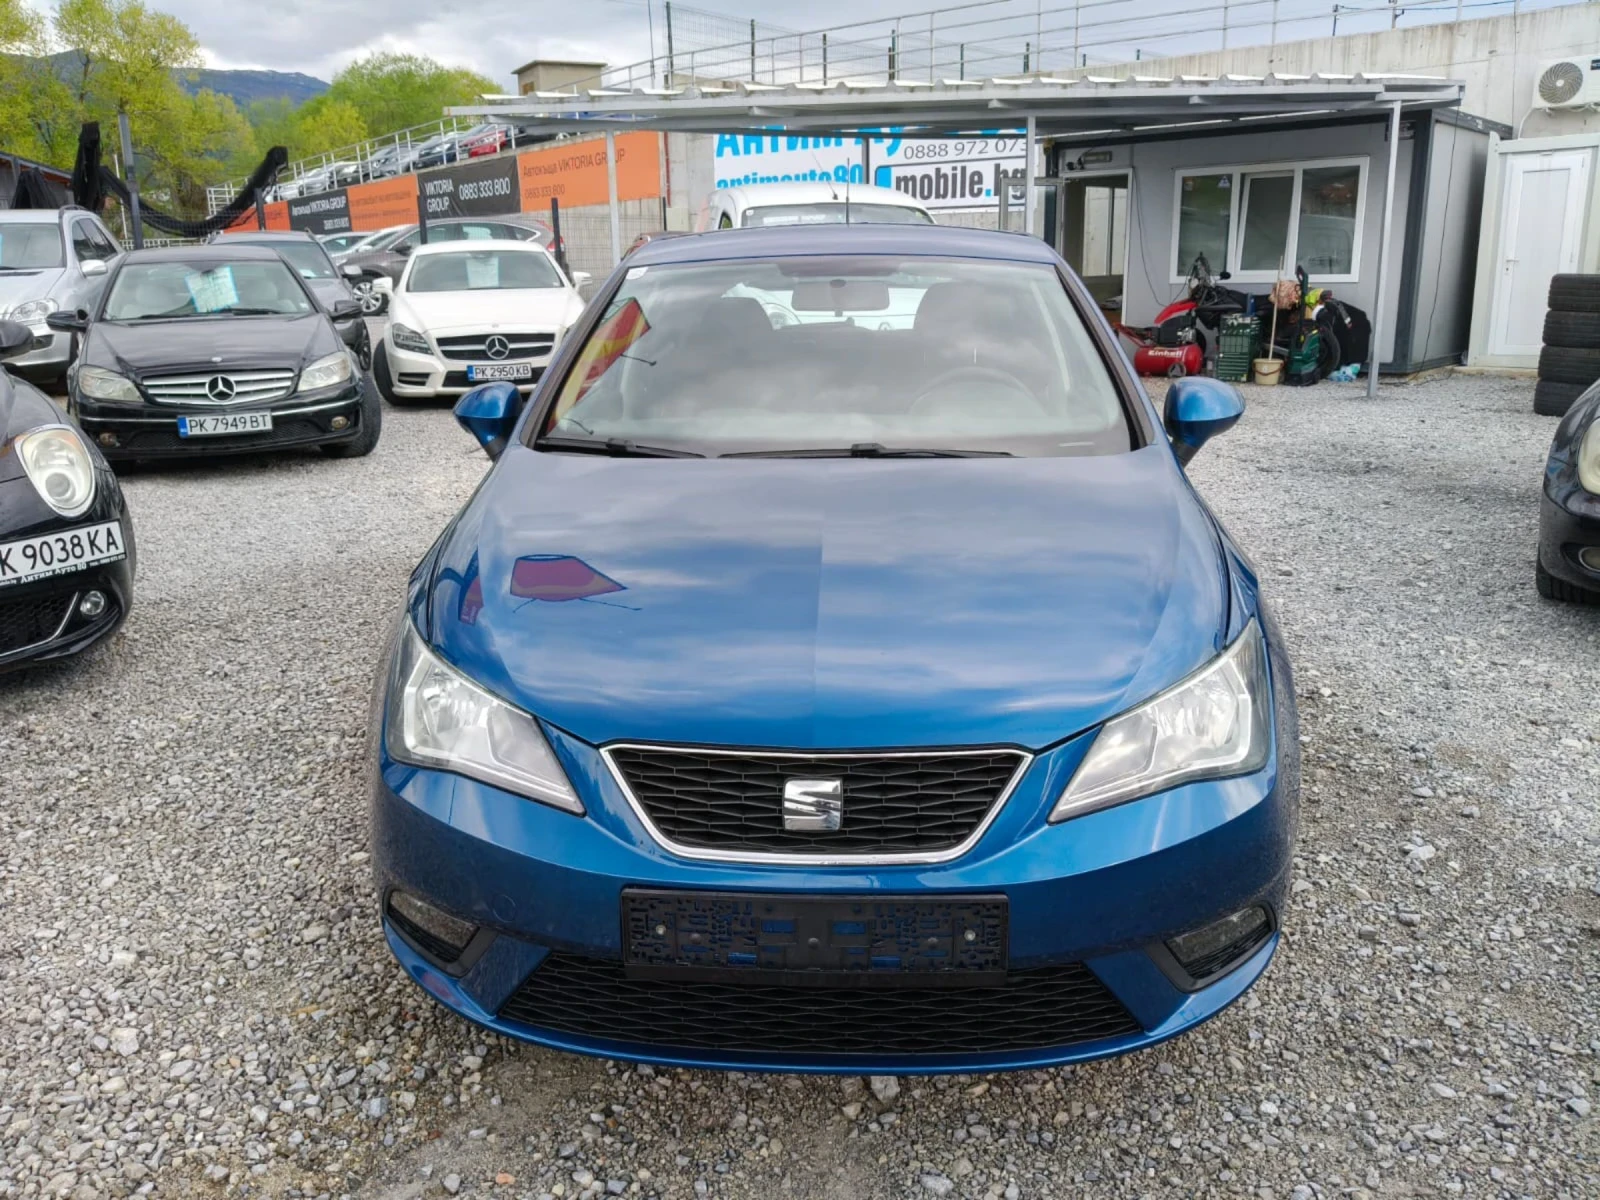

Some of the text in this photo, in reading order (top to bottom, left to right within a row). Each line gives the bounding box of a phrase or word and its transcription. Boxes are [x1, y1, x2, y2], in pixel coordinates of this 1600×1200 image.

[558, 153, 593, 172] VIKTORIA
[594, 148, 625, 166] GRUP
[904, 143, 948, 160] 0888
[954, 140, 989, 156] 972
[425, 179, 454, 195] VIKTORIA
[459, 177, 511, 200] 0883 333 800
[896, 163, 1026, 201] mobile.bg
[427, 197, 450, 212] GROUP
[475, 367, 488, 378] PK
[490, 366, 514, 377] 2950
[188, 414, 268, 433] PK 7949 BT
[0, 527, 119, 577] K 9038 KA
